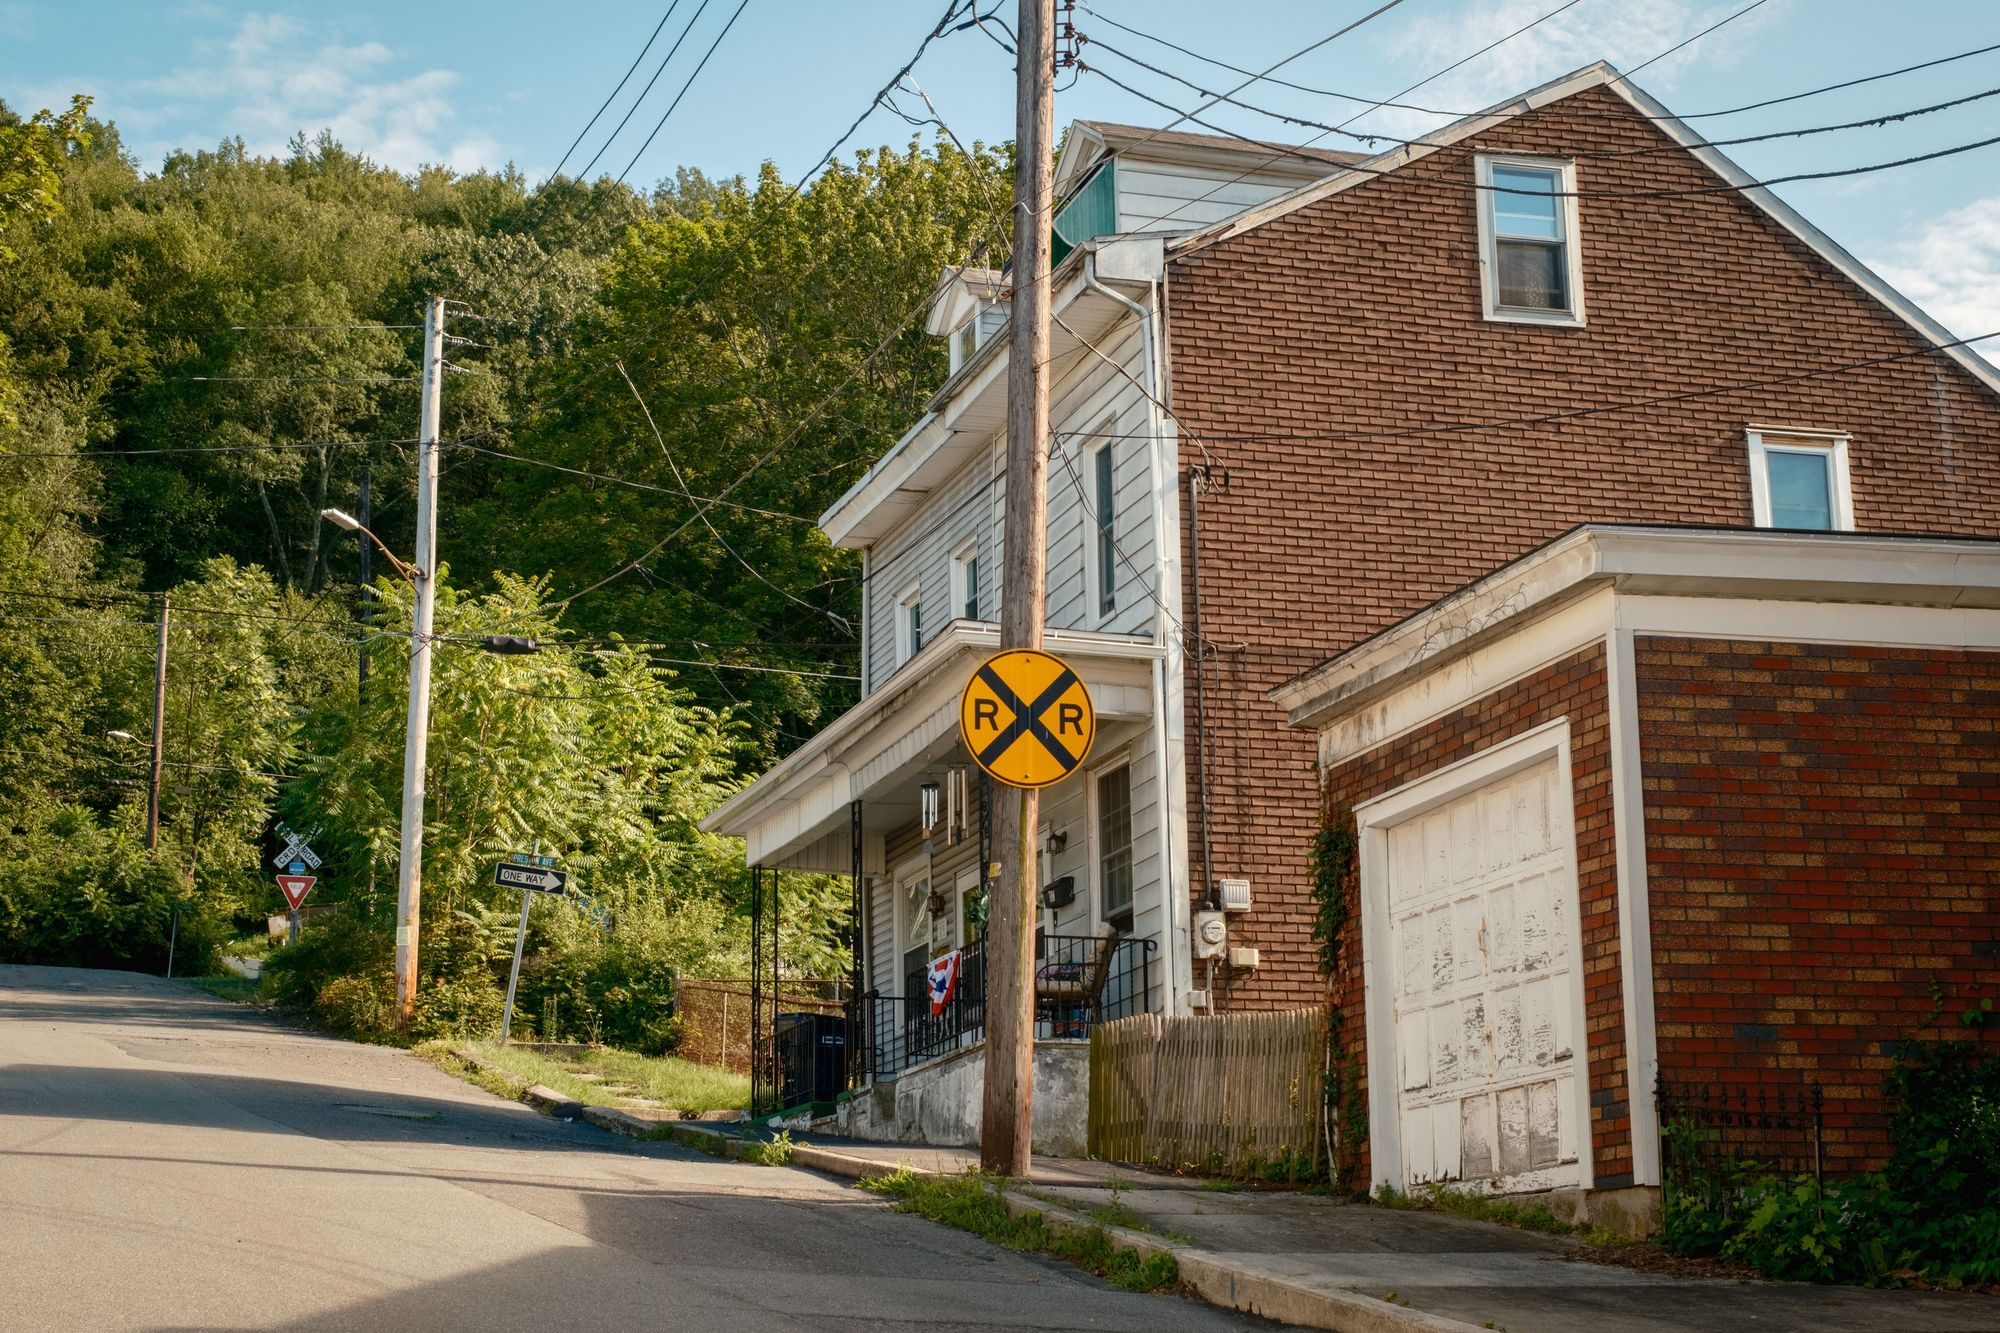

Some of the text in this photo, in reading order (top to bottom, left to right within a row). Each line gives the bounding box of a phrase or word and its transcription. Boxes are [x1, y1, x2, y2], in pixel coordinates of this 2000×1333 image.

[974, 698, 1084, 735] R R
[543, 857, 555, 867] AVE
[503, 870, 545, 884] ONE WAY
